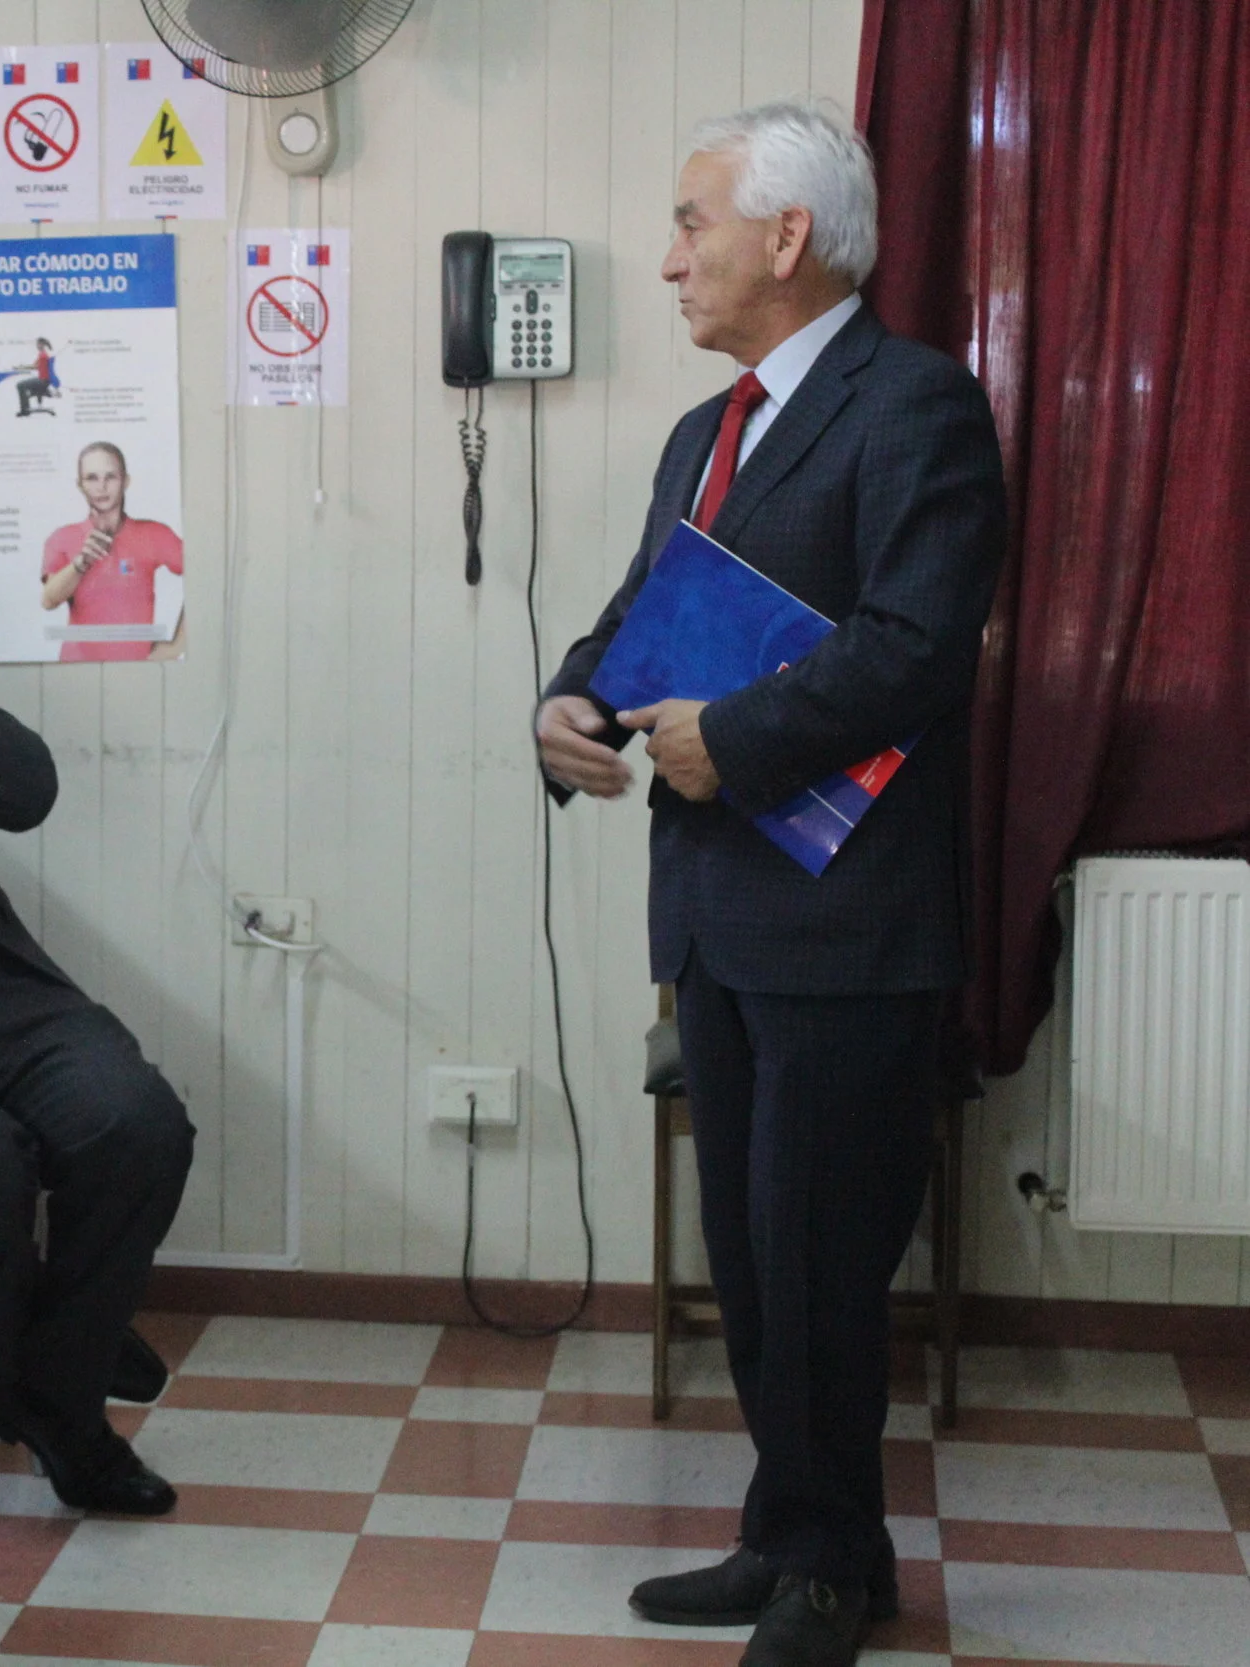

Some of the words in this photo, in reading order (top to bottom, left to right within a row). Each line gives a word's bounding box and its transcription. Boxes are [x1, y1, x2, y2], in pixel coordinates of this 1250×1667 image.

[15, 185, 30, 194] NO
[33, 184, 69, 193] FUMAR
[24, 252, 110, 273] CÓMODO
[113, 252, 139, 270] EN
[18, 278, 43, 296] DE
[46, 275, 128, 295] TRABAJO
